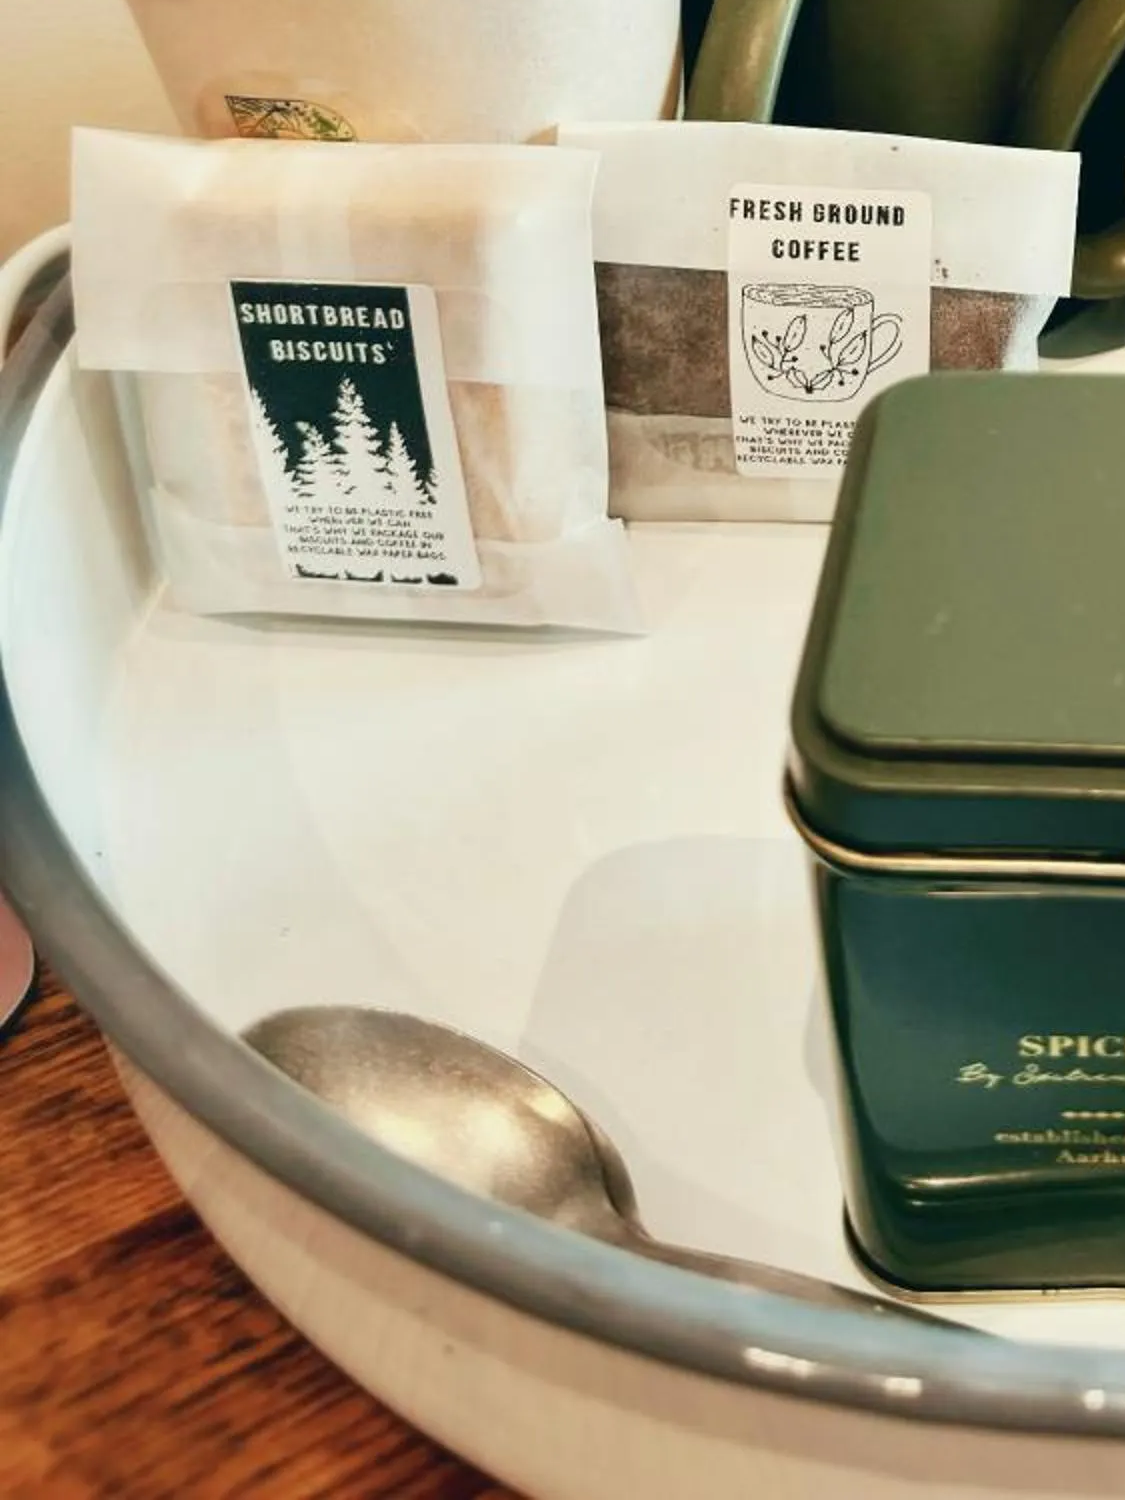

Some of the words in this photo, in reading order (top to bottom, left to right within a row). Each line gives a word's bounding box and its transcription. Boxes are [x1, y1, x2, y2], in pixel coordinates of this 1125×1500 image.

[730, 198, 802, 223] FRESH
[813, 203, 905, 227] GROUND
[771, 239, 861, 262] COFFEE
[240, 303, 405, 330] SHORTBREAD
[269, 339, 387, 365] BISCUITS
[740, 416, 755, 424] WE
[785, 417, 801, 426] TO
[955, 1062, 1004, 1088] By
